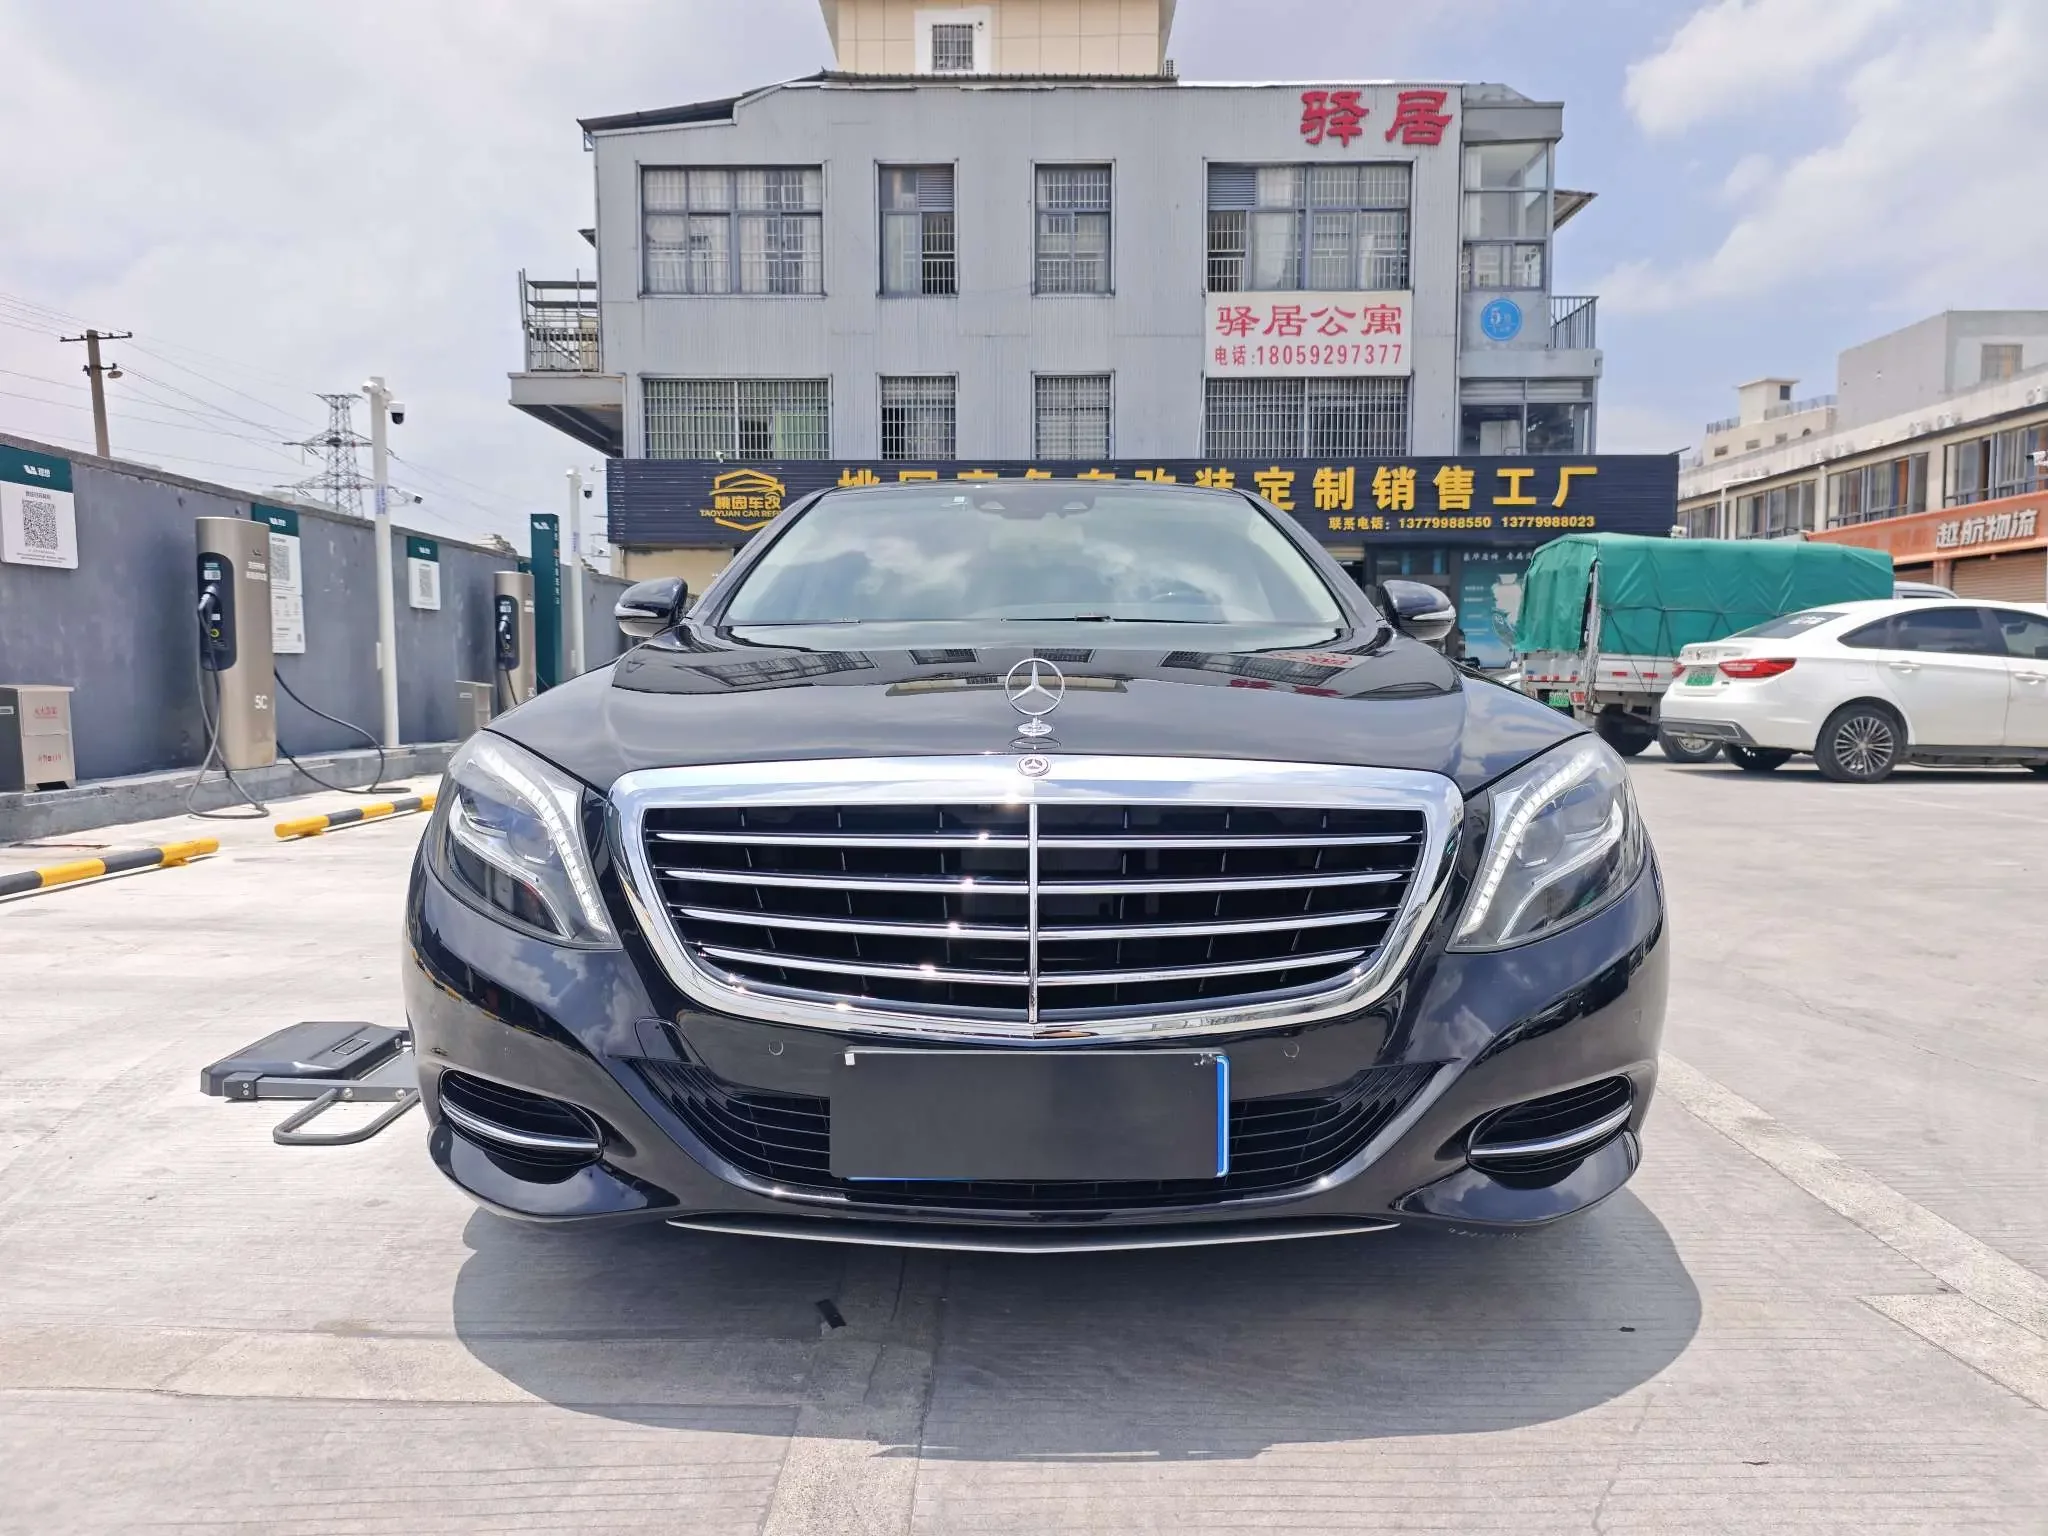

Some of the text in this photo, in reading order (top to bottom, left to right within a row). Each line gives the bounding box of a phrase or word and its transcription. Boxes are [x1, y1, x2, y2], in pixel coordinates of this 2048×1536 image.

[1300, 90, 1453, 147] 驿居
[1216, 304, 1402, 338] 驿居公寓
[715, 493, 781, 509] 桃园车改
[700, 509, 741, 518] TAOYUAN
[742, 509, 760, 518] CAR
[1398, 517, 1492, 529] 13779988550
[1501, 516, 1596, 528] 13779988023
[1936, 509, 2038, 548] 越航物流
[254, 694, 269, 710] 5C
